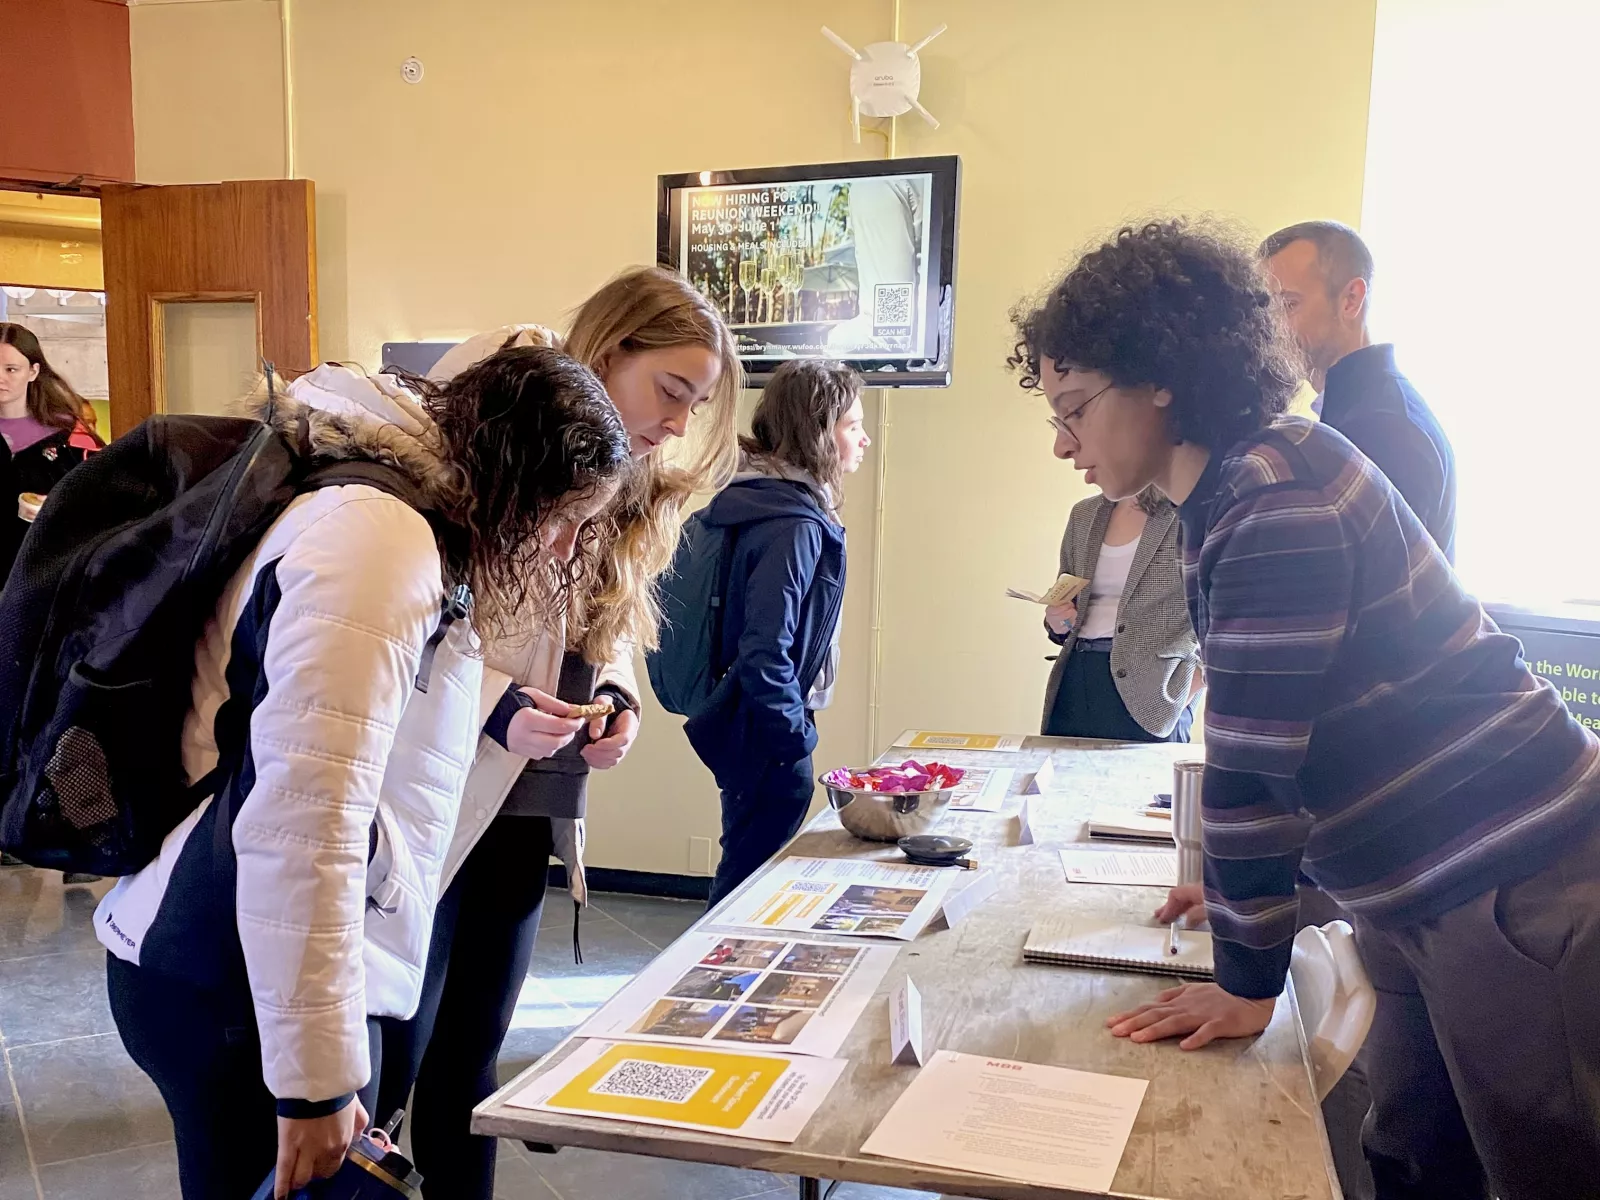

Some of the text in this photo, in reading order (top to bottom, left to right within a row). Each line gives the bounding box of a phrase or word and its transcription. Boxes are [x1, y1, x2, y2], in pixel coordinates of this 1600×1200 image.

[725, 192, 770, 205] HIRING
[773, 190, 798, 202] FOR
[692, 207, 748, 221] REUNION
[691, 223, 716, 237] May
[691, 243, 729, 253] HOUSING
[729, 242, 736, 251] &
[737, 241, 765, 251] MEALS
[877, 328, 907, 336] SCAN ME
[1536, 660, 1562, 676] the
[1565, 662, 1600, 680] Wor
